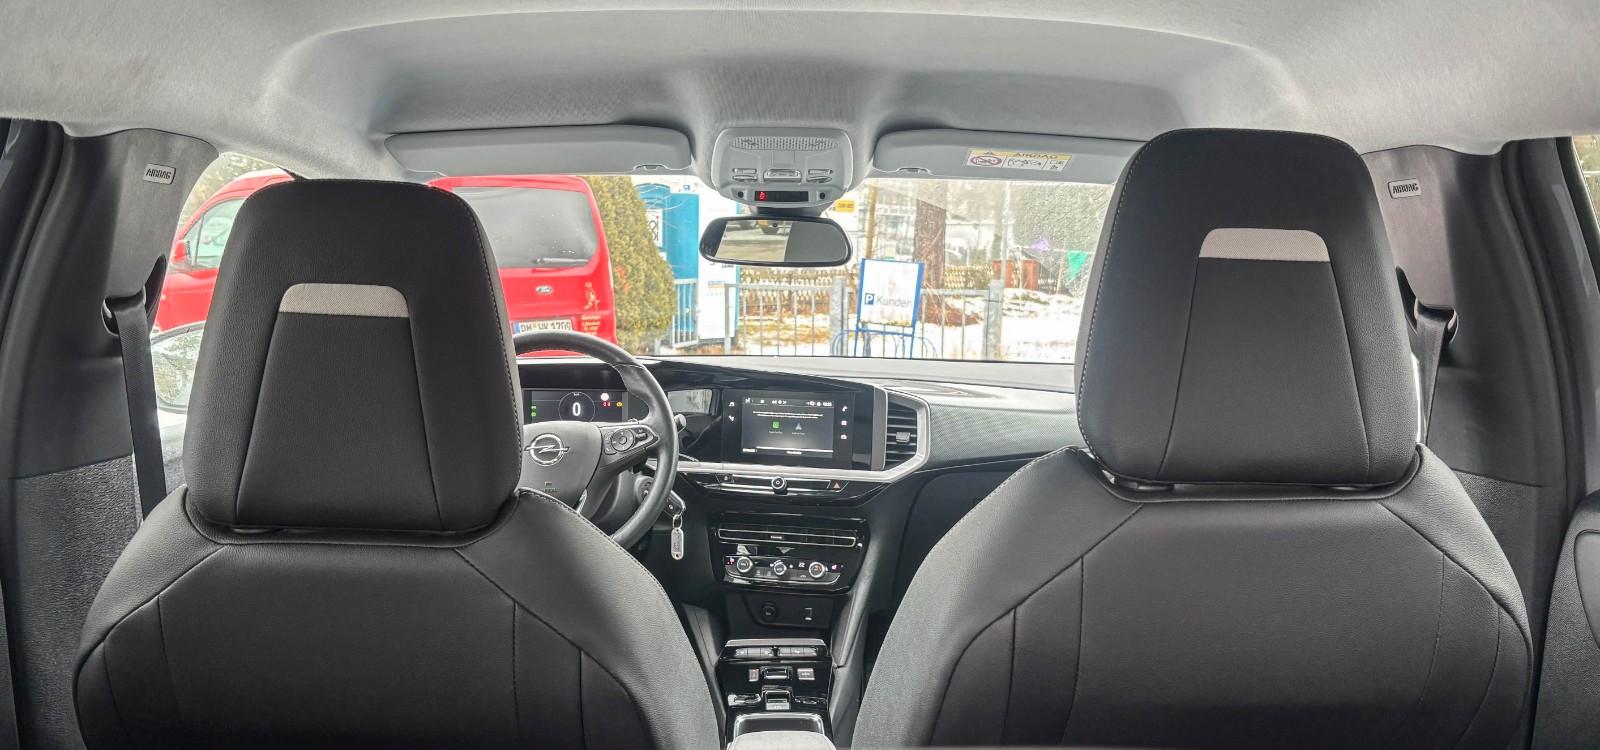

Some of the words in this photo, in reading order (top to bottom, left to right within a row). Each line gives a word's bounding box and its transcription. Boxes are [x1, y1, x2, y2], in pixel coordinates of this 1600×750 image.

[145, 168, 172, 179] AIRBAG
[1392, 183, 1419, 194] AIRBAG
[877, 296, 912, 307] Kunden
[572, 402, 581, 417] 0
